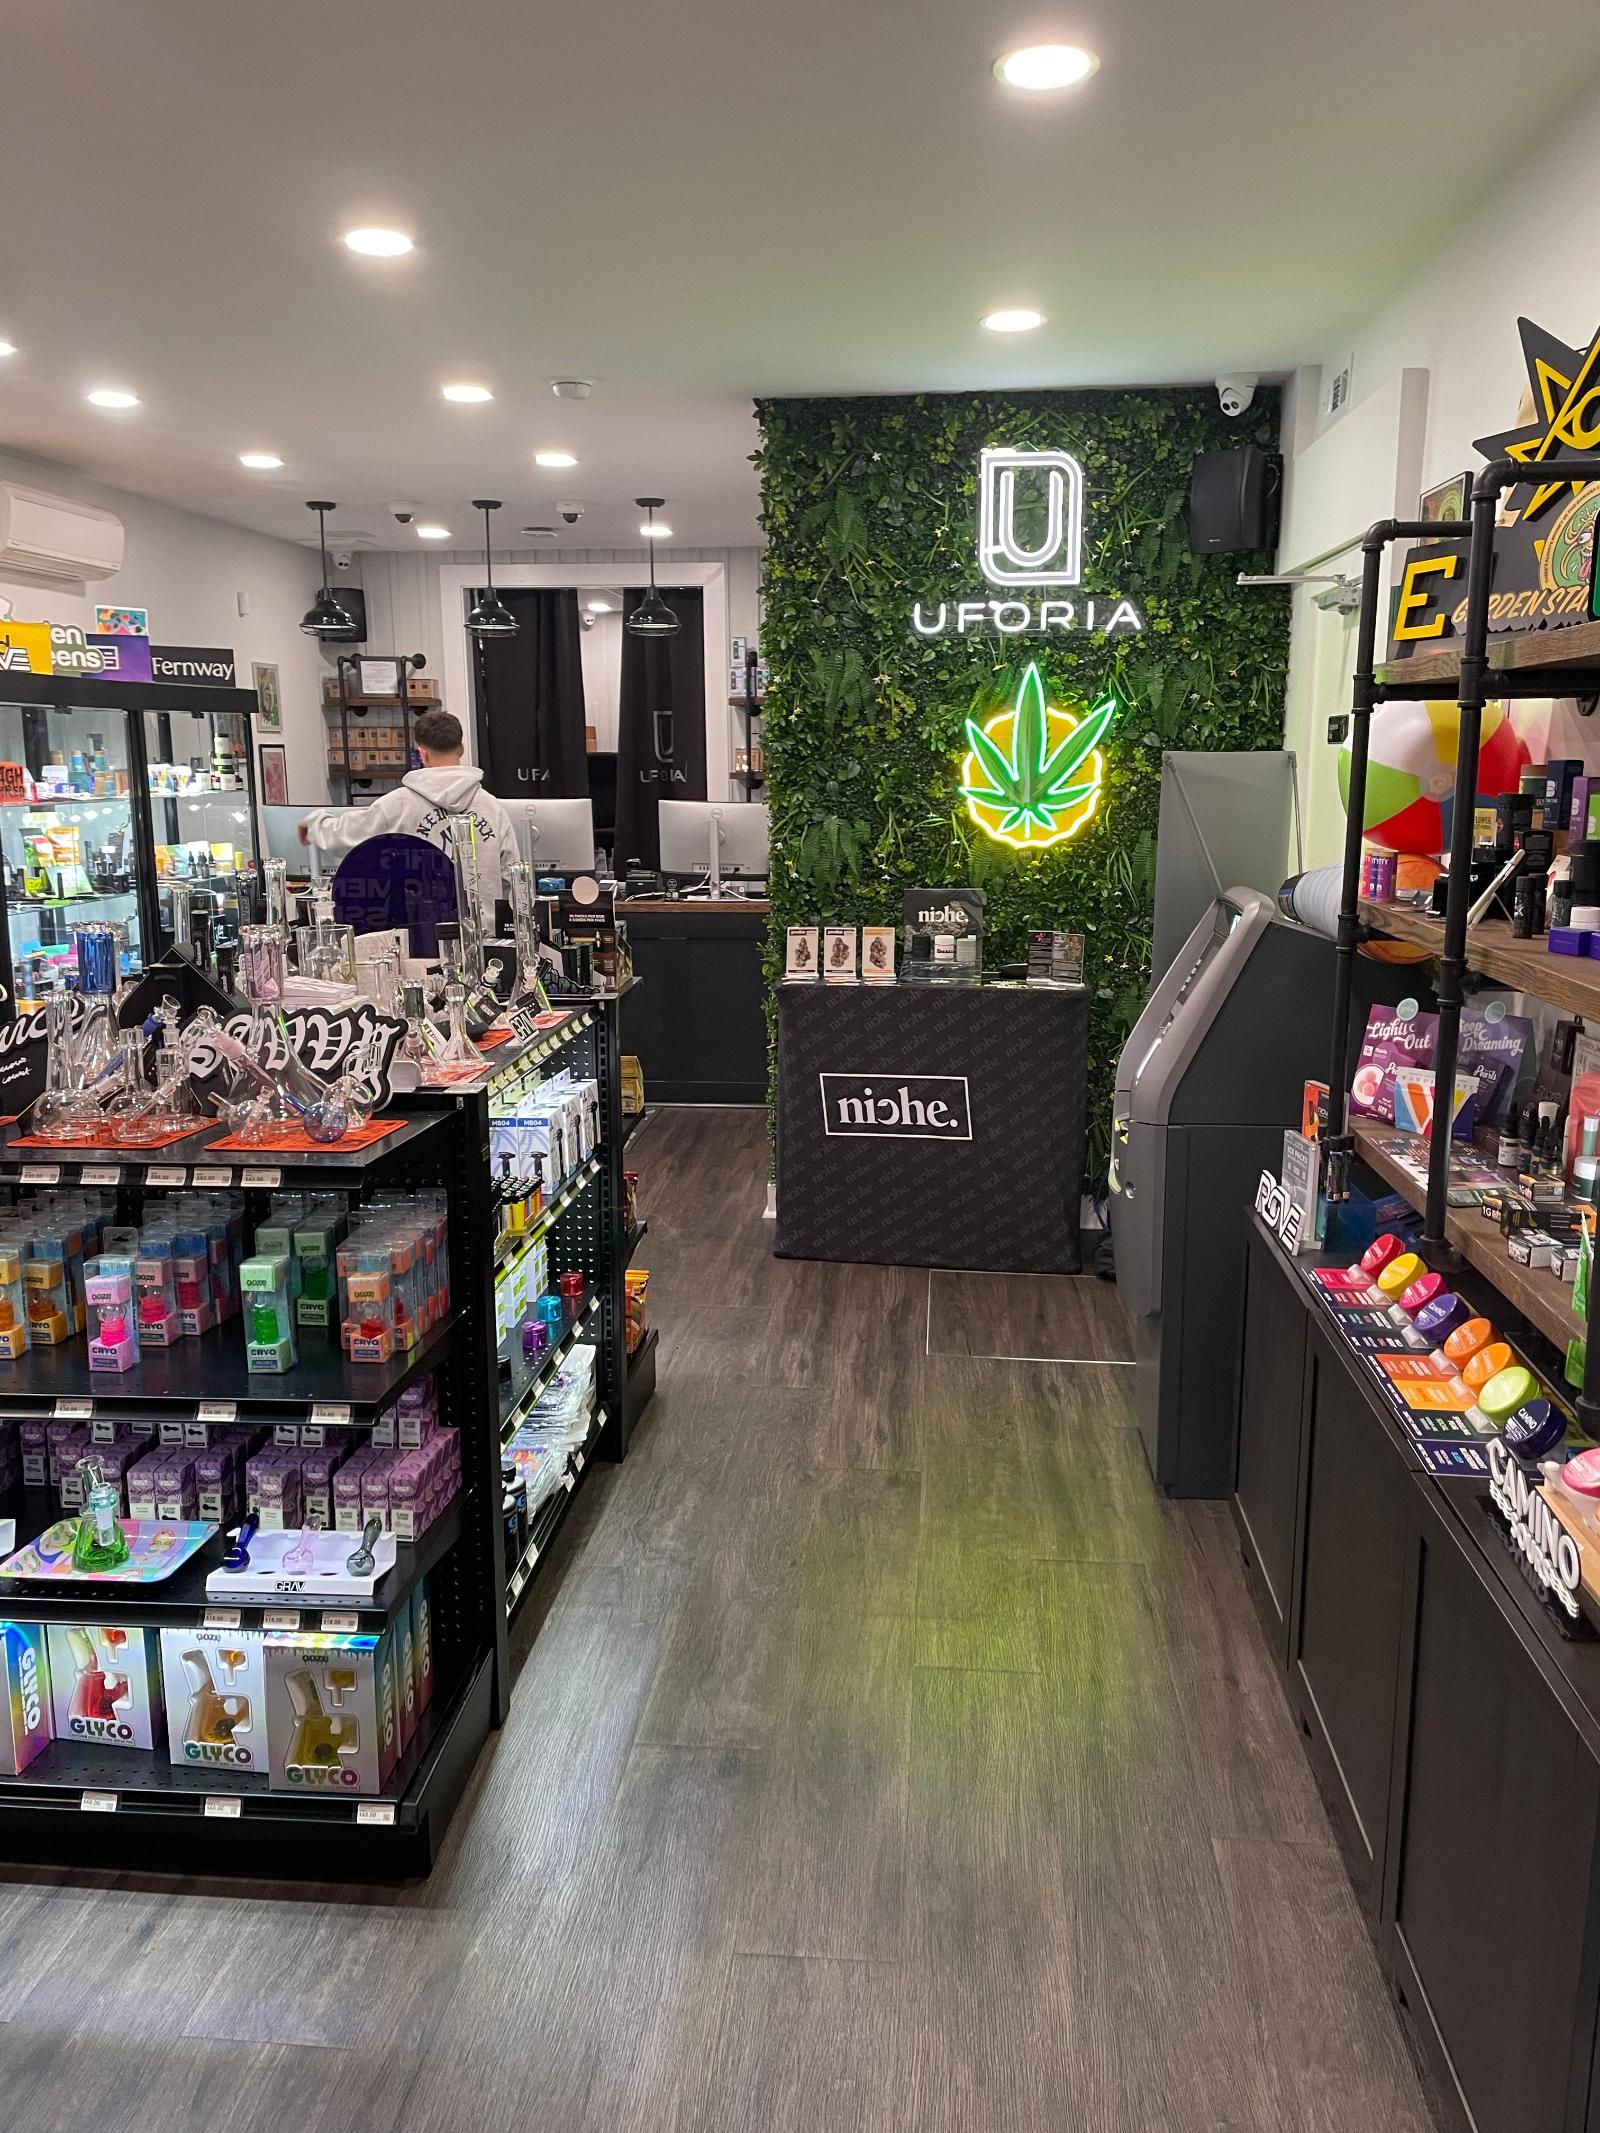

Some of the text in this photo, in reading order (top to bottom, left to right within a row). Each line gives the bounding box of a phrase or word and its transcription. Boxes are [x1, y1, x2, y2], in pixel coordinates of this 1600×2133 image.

[1451, 584, 1589, 624] GRDEN STA
[913, 600, 1142, 634] UFORIA
[51, 649, 101, 668] eens
[152, 656, 234, 681] Fernway
[918, 906, 969, 923] niche.
[1366, 1017, 1407, 1041] Lights
[1394, 1033, 1431, 1050] Out
[1462, 1035, 1524, 1056] Dreaming
[836, 1086, 958, 1128] niche.
[1254, 1169, 1308, 1257] ROVE
[92, 1346, 117, 1355] CRYO
[250, 1348, 276, 1356] CRYO
[1517, 1407, 1538, 1430] CAMINO
[1486, 1437, 1580, 1590] CAMINO
[22, 1647, 41, 1730] GLYCO
[69, 1718, 134, 1740] GLYCO
[184, 1740, 252, 1764] GLYCO
[286, 1766, 359, 1786] GLYCO
